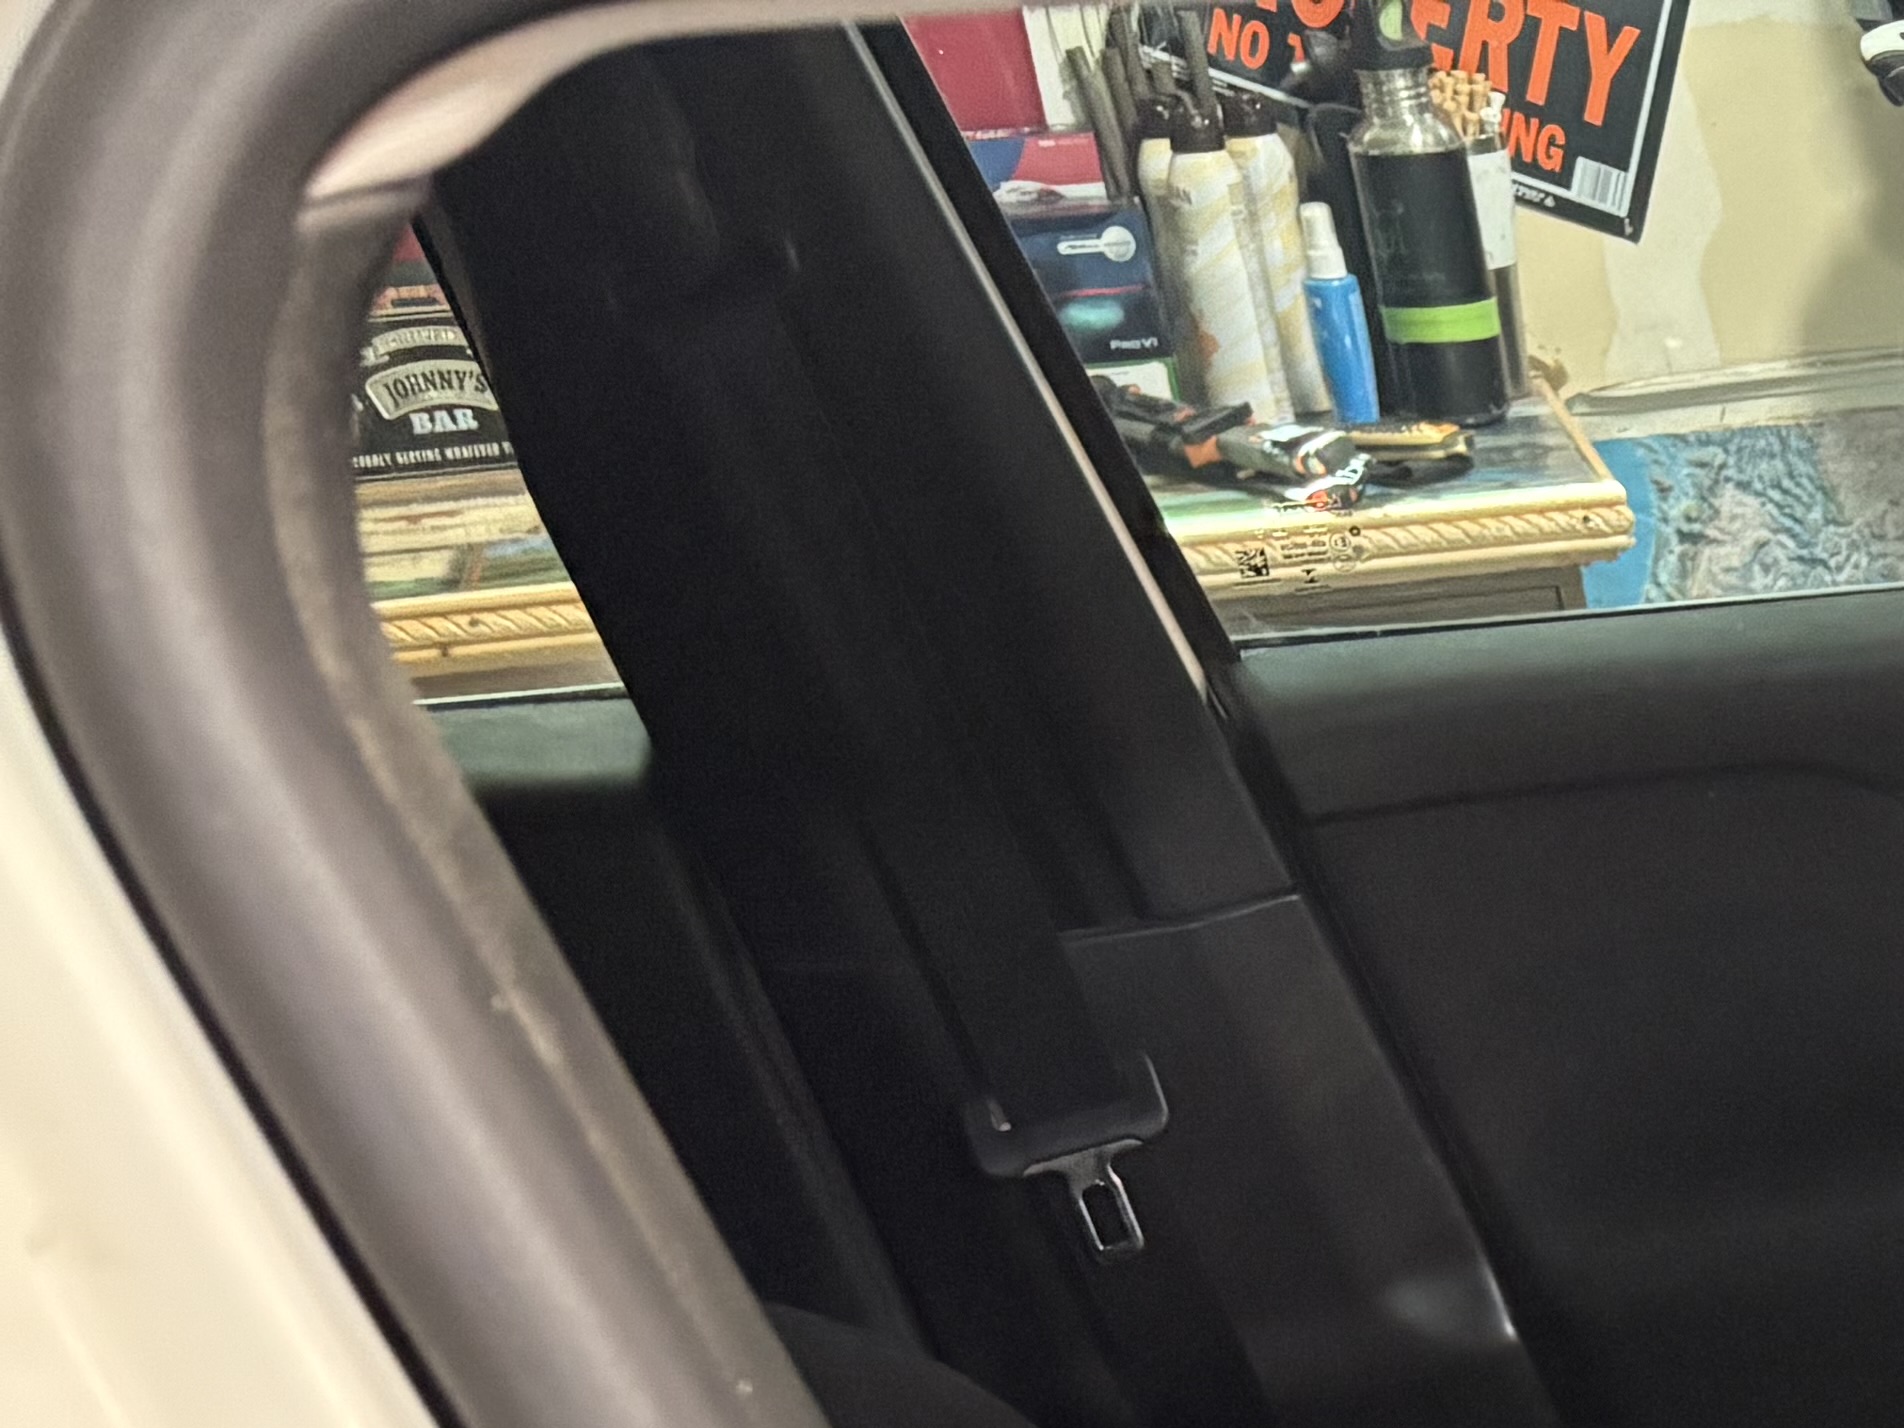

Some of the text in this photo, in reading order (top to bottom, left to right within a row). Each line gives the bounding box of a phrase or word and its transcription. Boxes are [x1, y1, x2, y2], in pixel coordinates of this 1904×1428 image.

[1207, 8, 1270, 70] NO
[383, 369, 489, 409] JOHNNY'S
[409, 408, 479, 435] BAR
